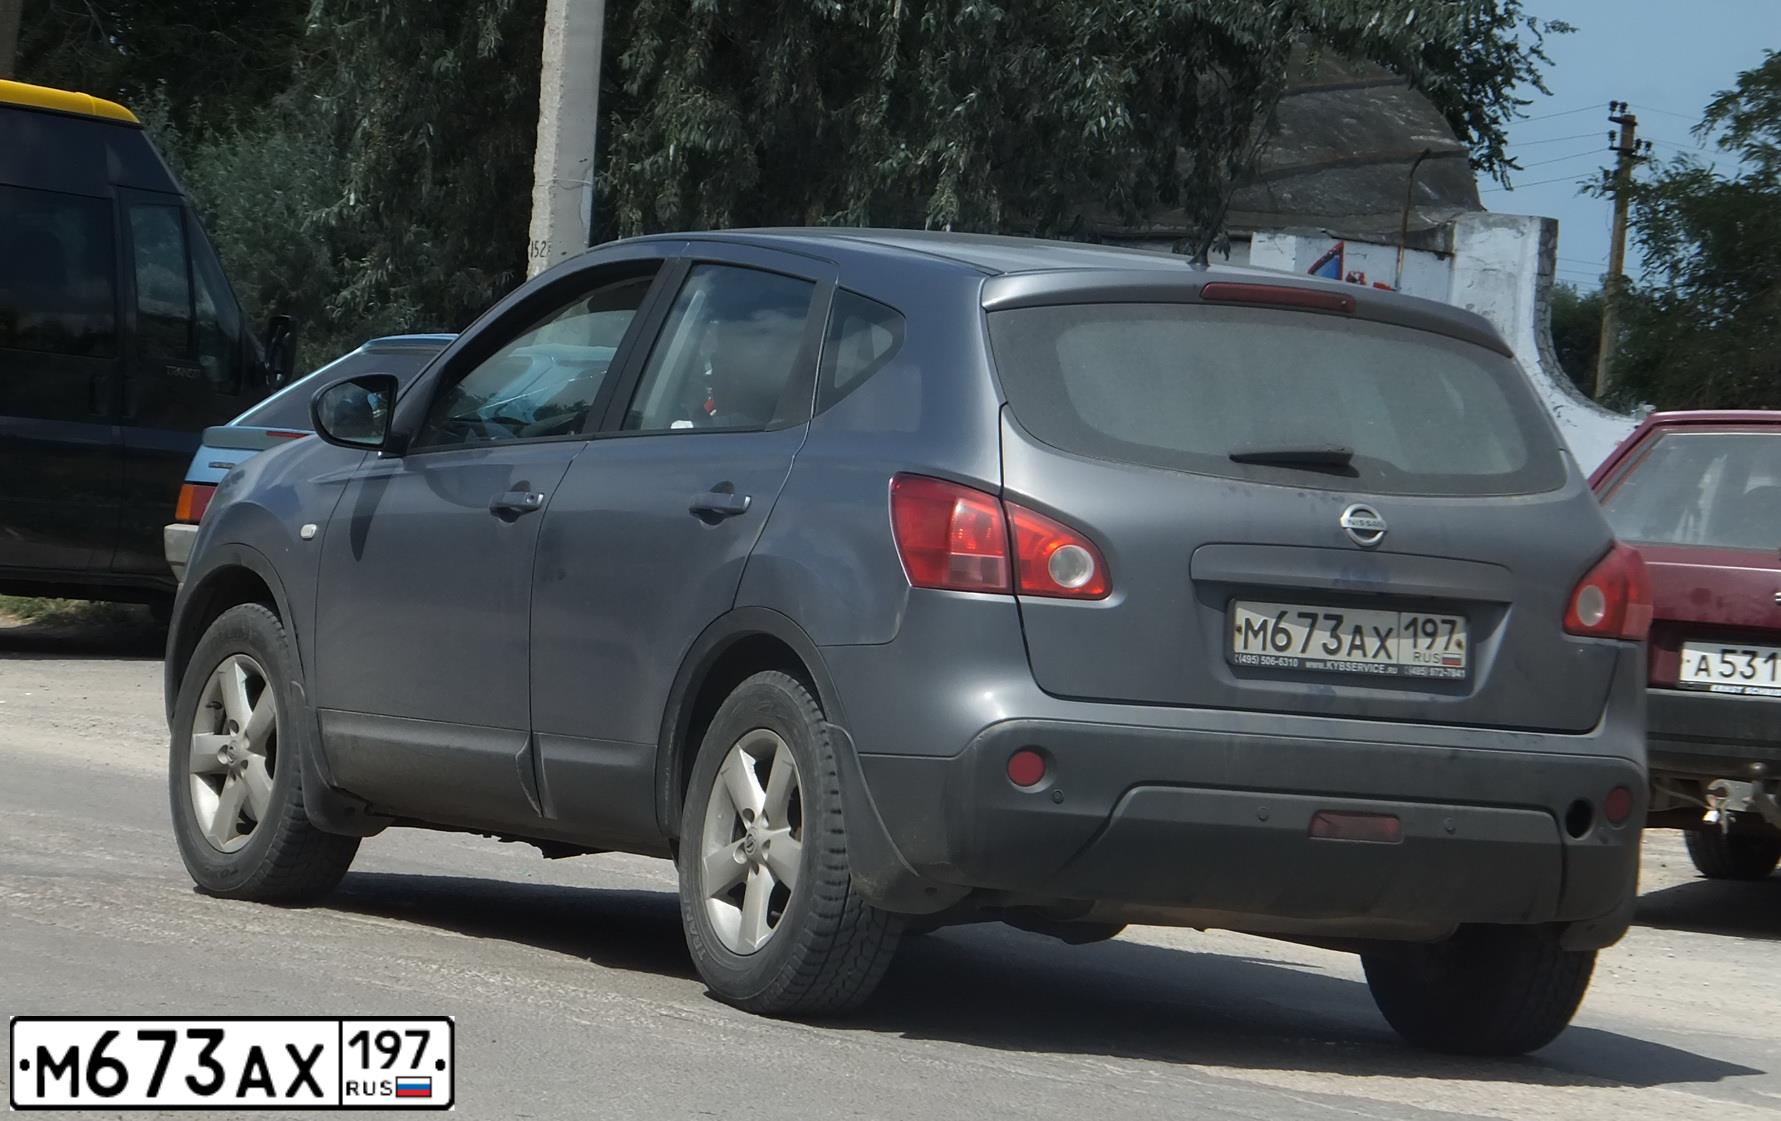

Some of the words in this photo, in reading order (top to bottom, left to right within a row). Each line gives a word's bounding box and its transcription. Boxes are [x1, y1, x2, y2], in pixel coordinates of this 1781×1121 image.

[1346, 519, 1385, 528] NISSAN
[1404, 616, 1458, 651] 197
[1413, 651, 1441, 665] RUS
